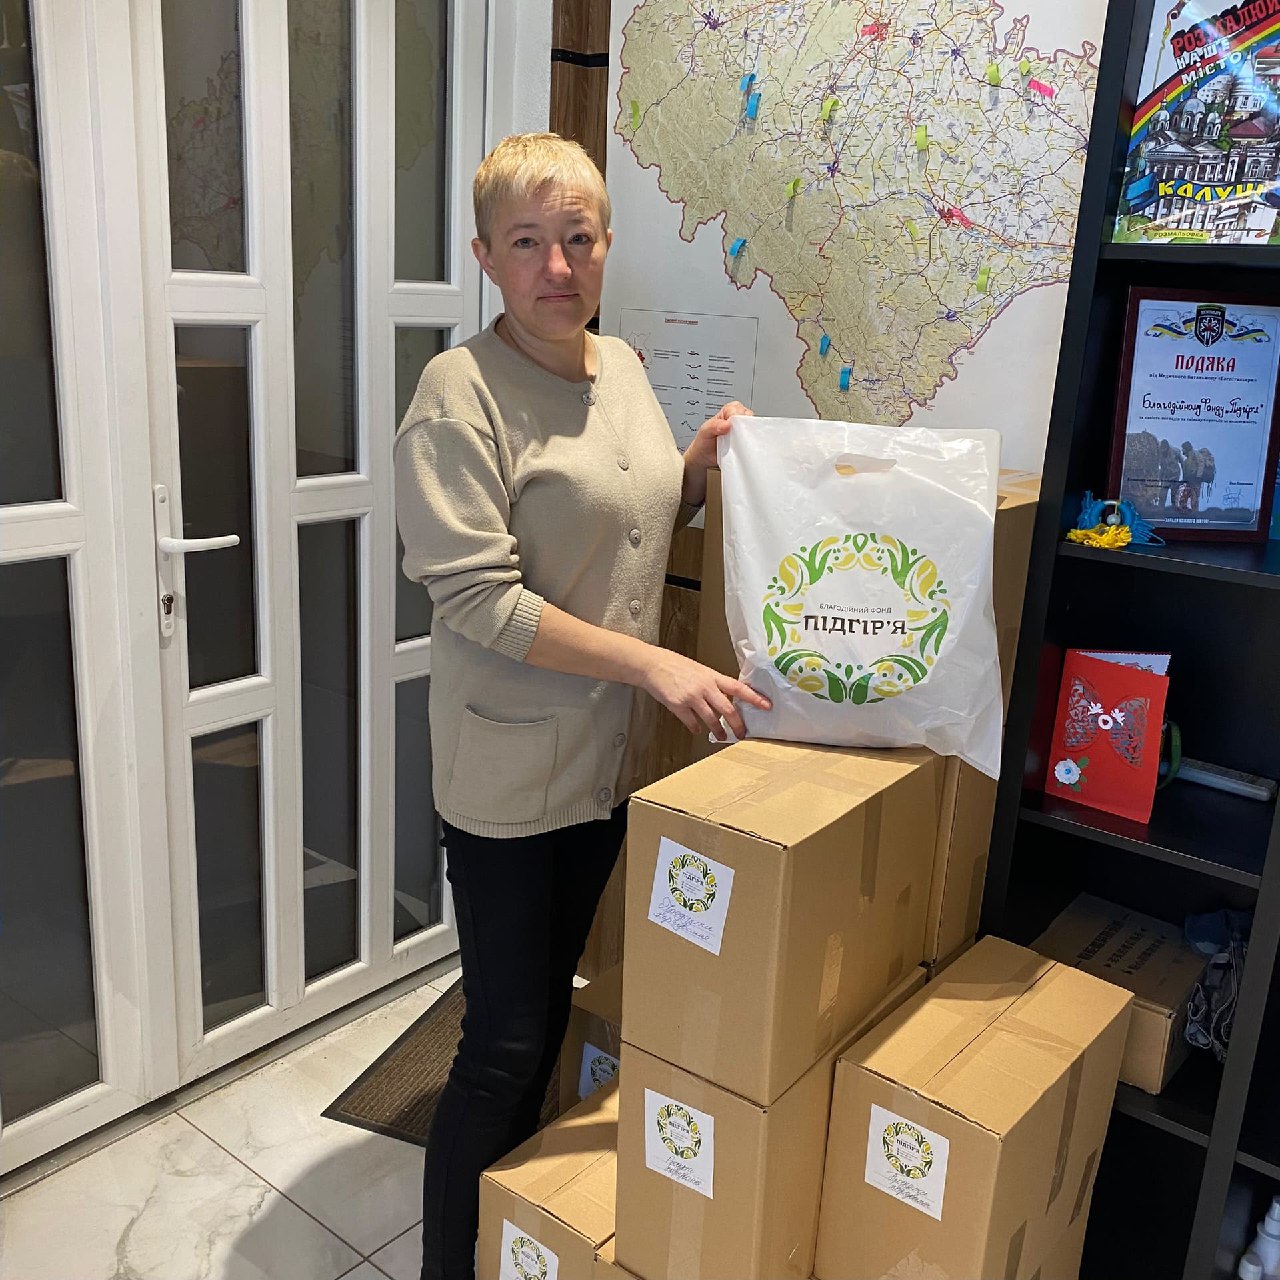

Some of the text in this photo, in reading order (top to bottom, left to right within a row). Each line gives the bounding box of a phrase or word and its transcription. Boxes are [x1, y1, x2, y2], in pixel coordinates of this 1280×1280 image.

[1158, 180, 1264, 201] КАЛУШ
[1175, 354, 1236, 373] ПОДЯКА
[870, 606, 892, 614] ФОНД
[803, 614, 907, 636] ПІДГІР'Я
